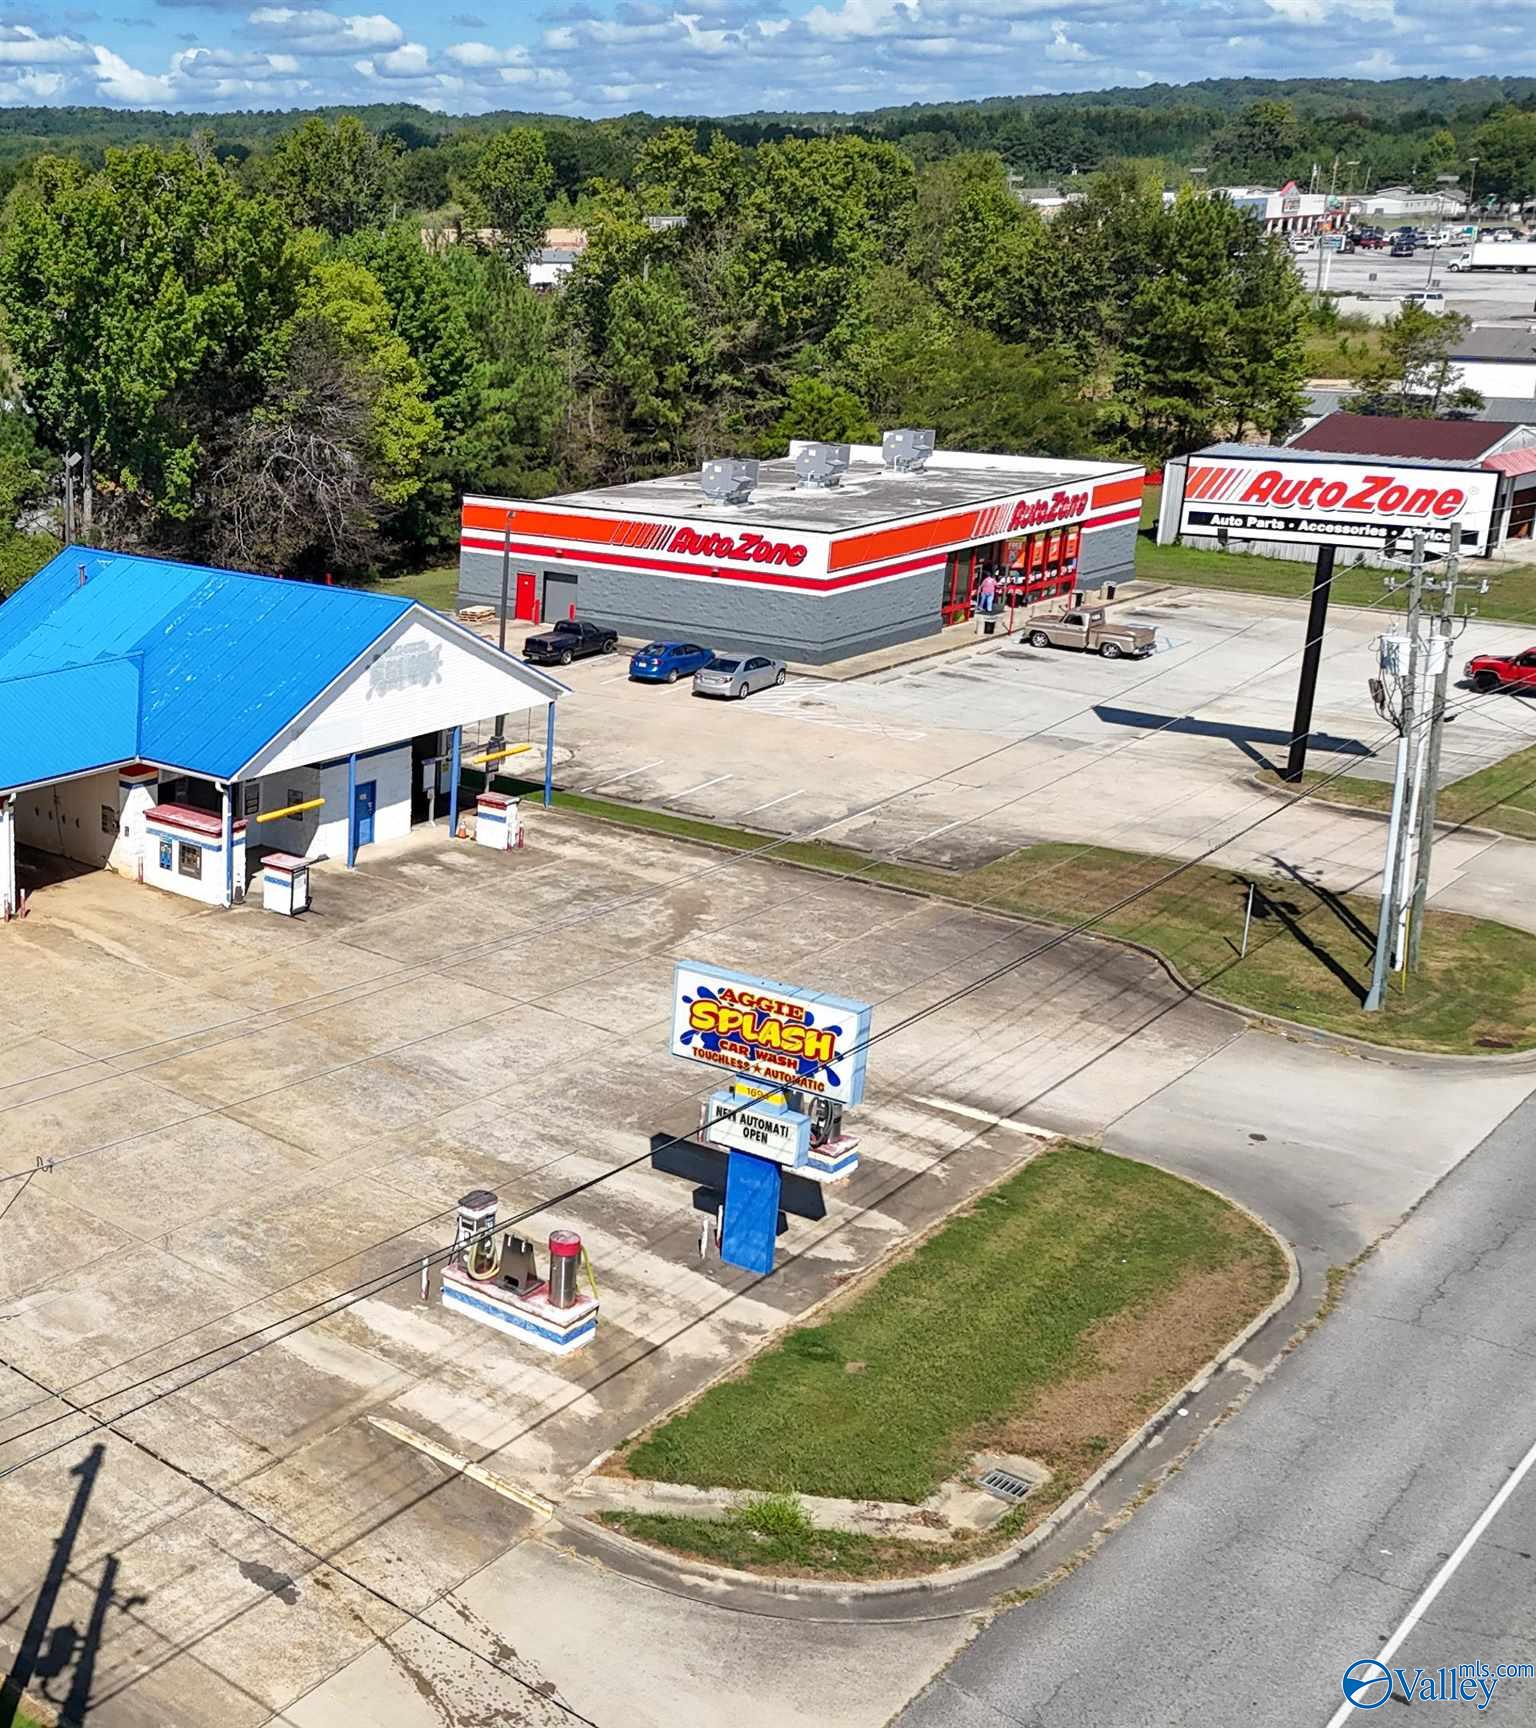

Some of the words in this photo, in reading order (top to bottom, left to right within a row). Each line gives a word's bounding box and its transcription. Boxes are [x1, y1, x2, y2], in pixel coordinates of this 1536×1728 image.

[1007, 491, 1088, 532] AutoZone
[1239, 470, 1467, 518] AutoZone
[667, 527, 808, 567] AutoZone
[1210, 514, 1243, 527] Auto
[1247, 516, 1285, 530] Parts
[1298, 520, 1387, 537] Accessories
[1401, 527, 1452, 542] Avice
[720, 988, 805, 1020] AGGIE
[689, 999, 836, 1063] SPLASH
[692, 1046, 751, 1072] TOUCHLESS
[764, 1067, 825, 1092] AUTOMATIC
[719, 1039, 749, 1057] CAR
[755, 1049, 798, 1070] WASH
[742, 1127, 768, 1144] OPEN
